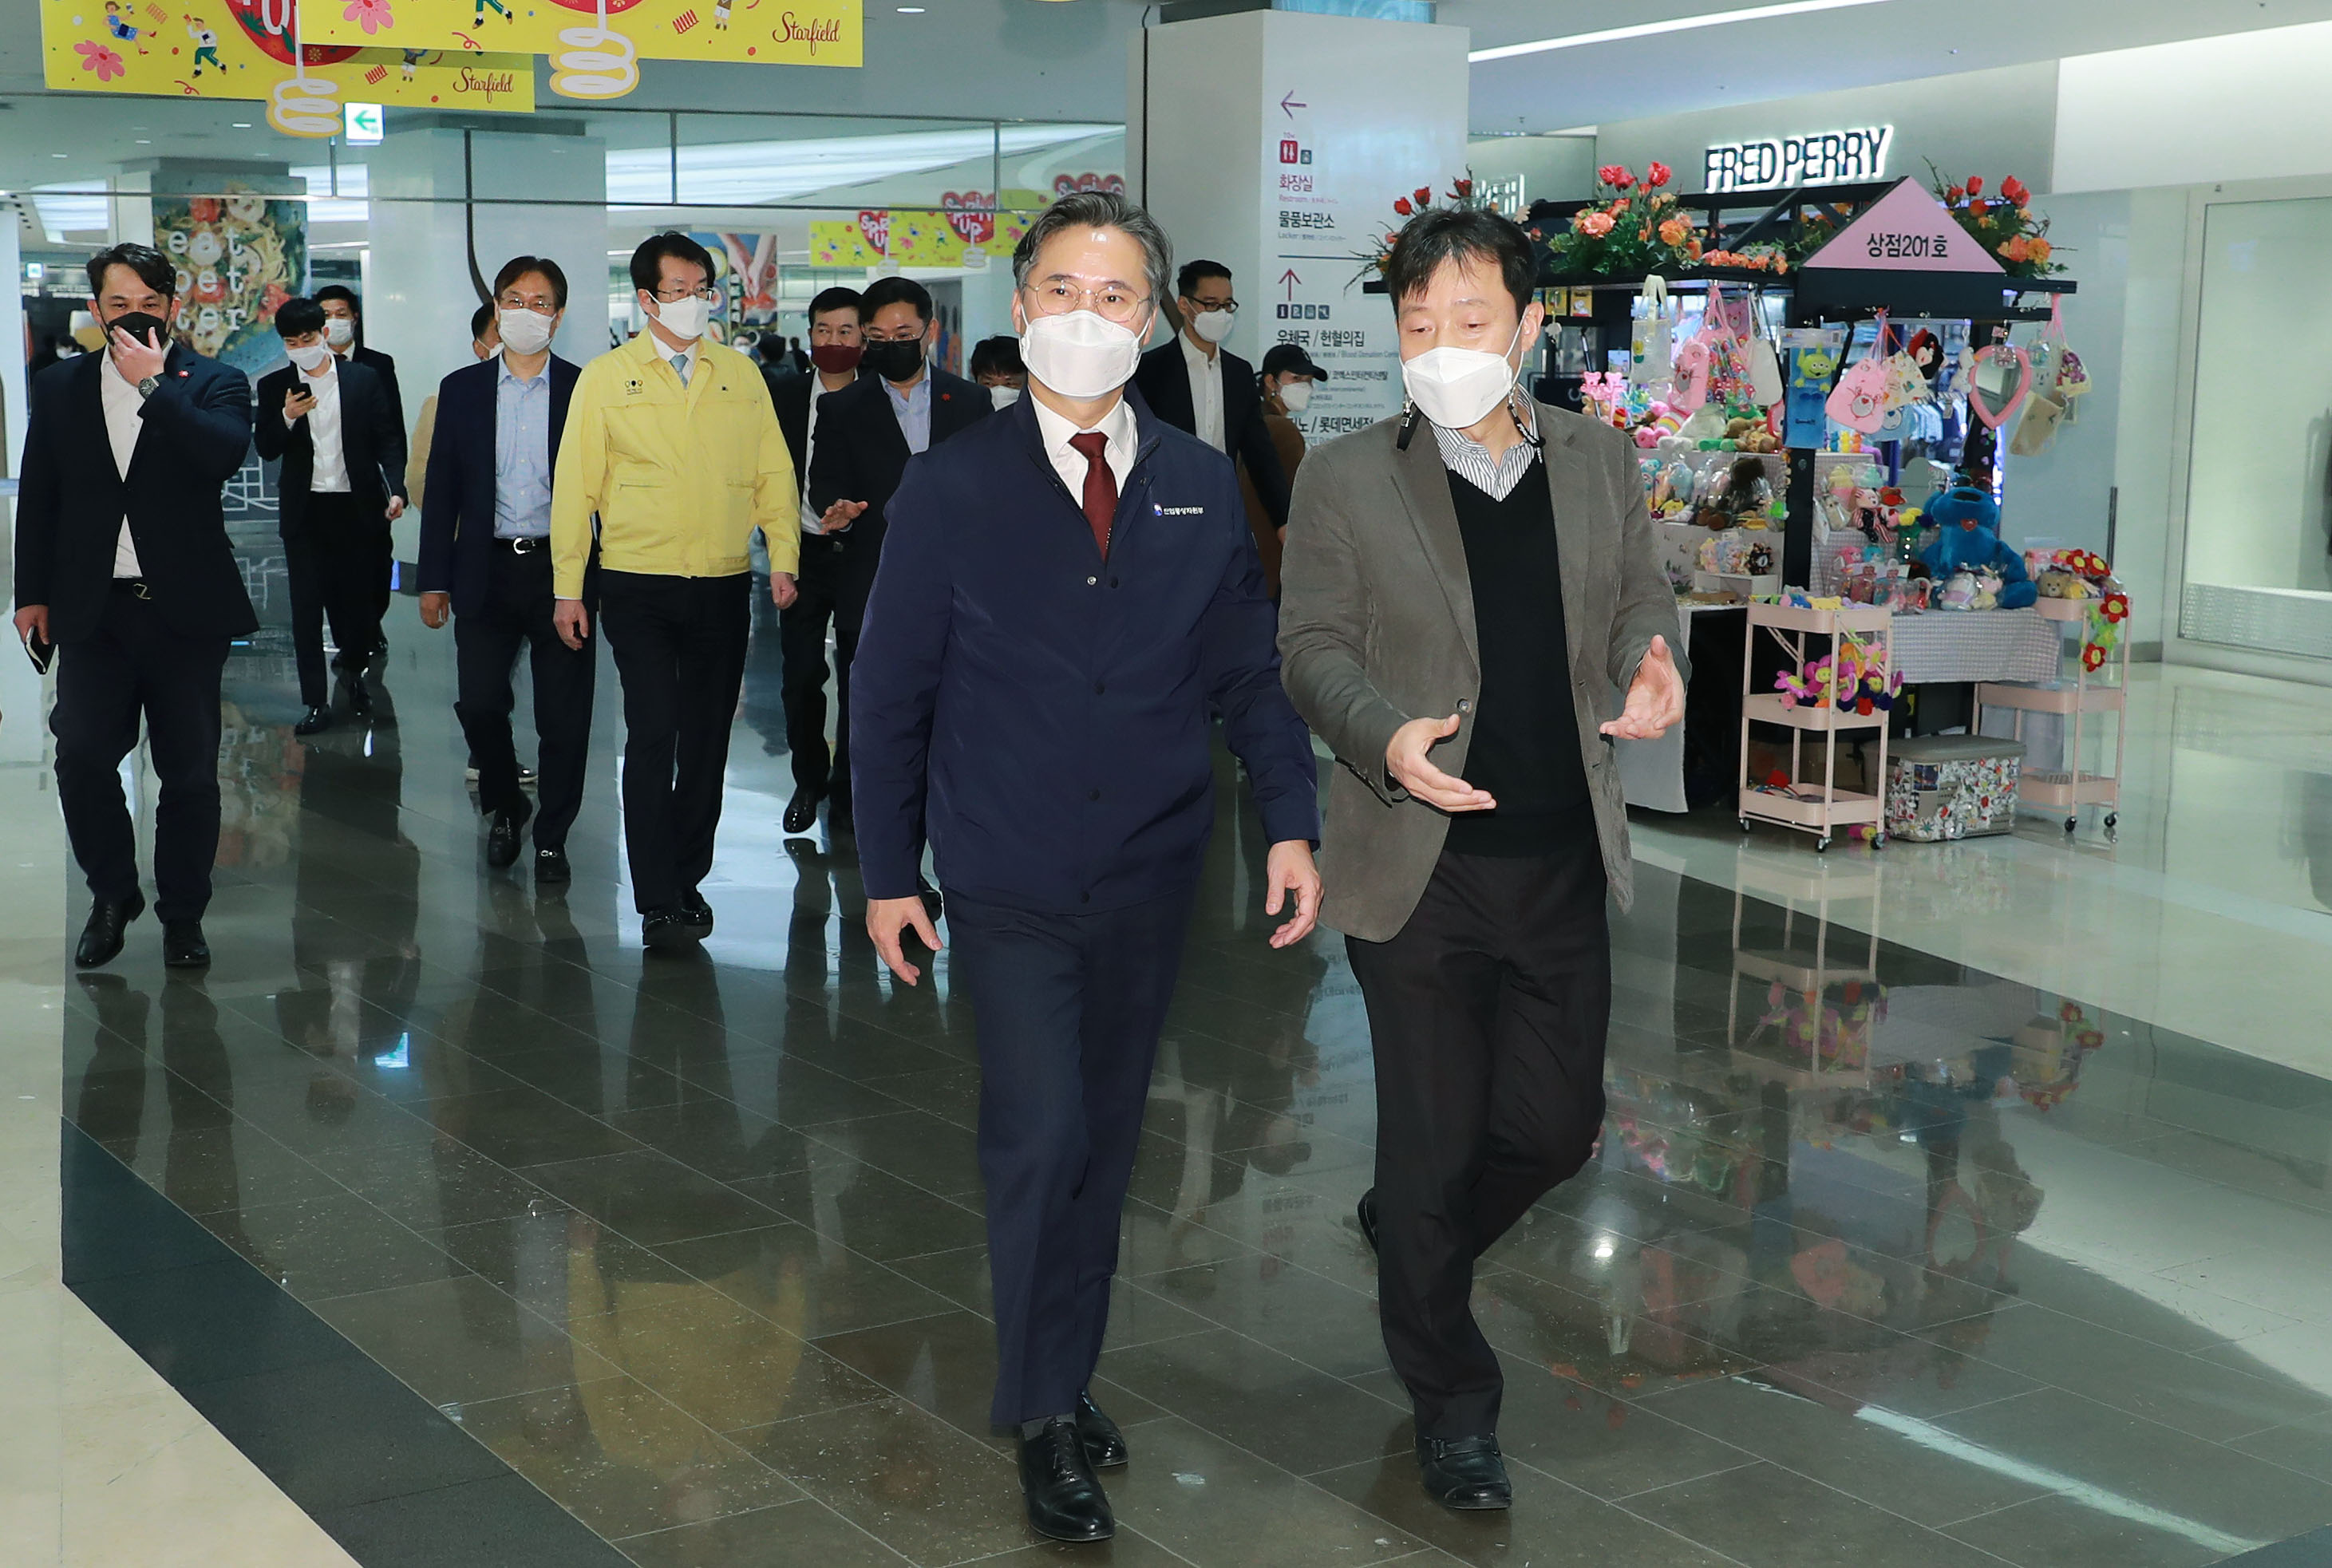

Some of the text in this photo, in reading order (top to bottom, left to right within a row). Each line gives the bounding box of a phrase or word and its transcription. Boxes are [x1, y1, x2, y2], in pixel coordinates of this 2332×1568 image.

[772, 10, 840, 57] Starfield
[453, 66, 514, 104] Starfield
[1704, 124, 1894, 193] FRED PERRY
[1279, 173, 1313, 192] 화장실
[1279, 211, 1334, 229] 물품보관소
[1867, 232, 1948, 258] 상점201호
[1277, 329, 1310, 346] 우체국
[1320, 330, 1365, 347] 헌혈의집
